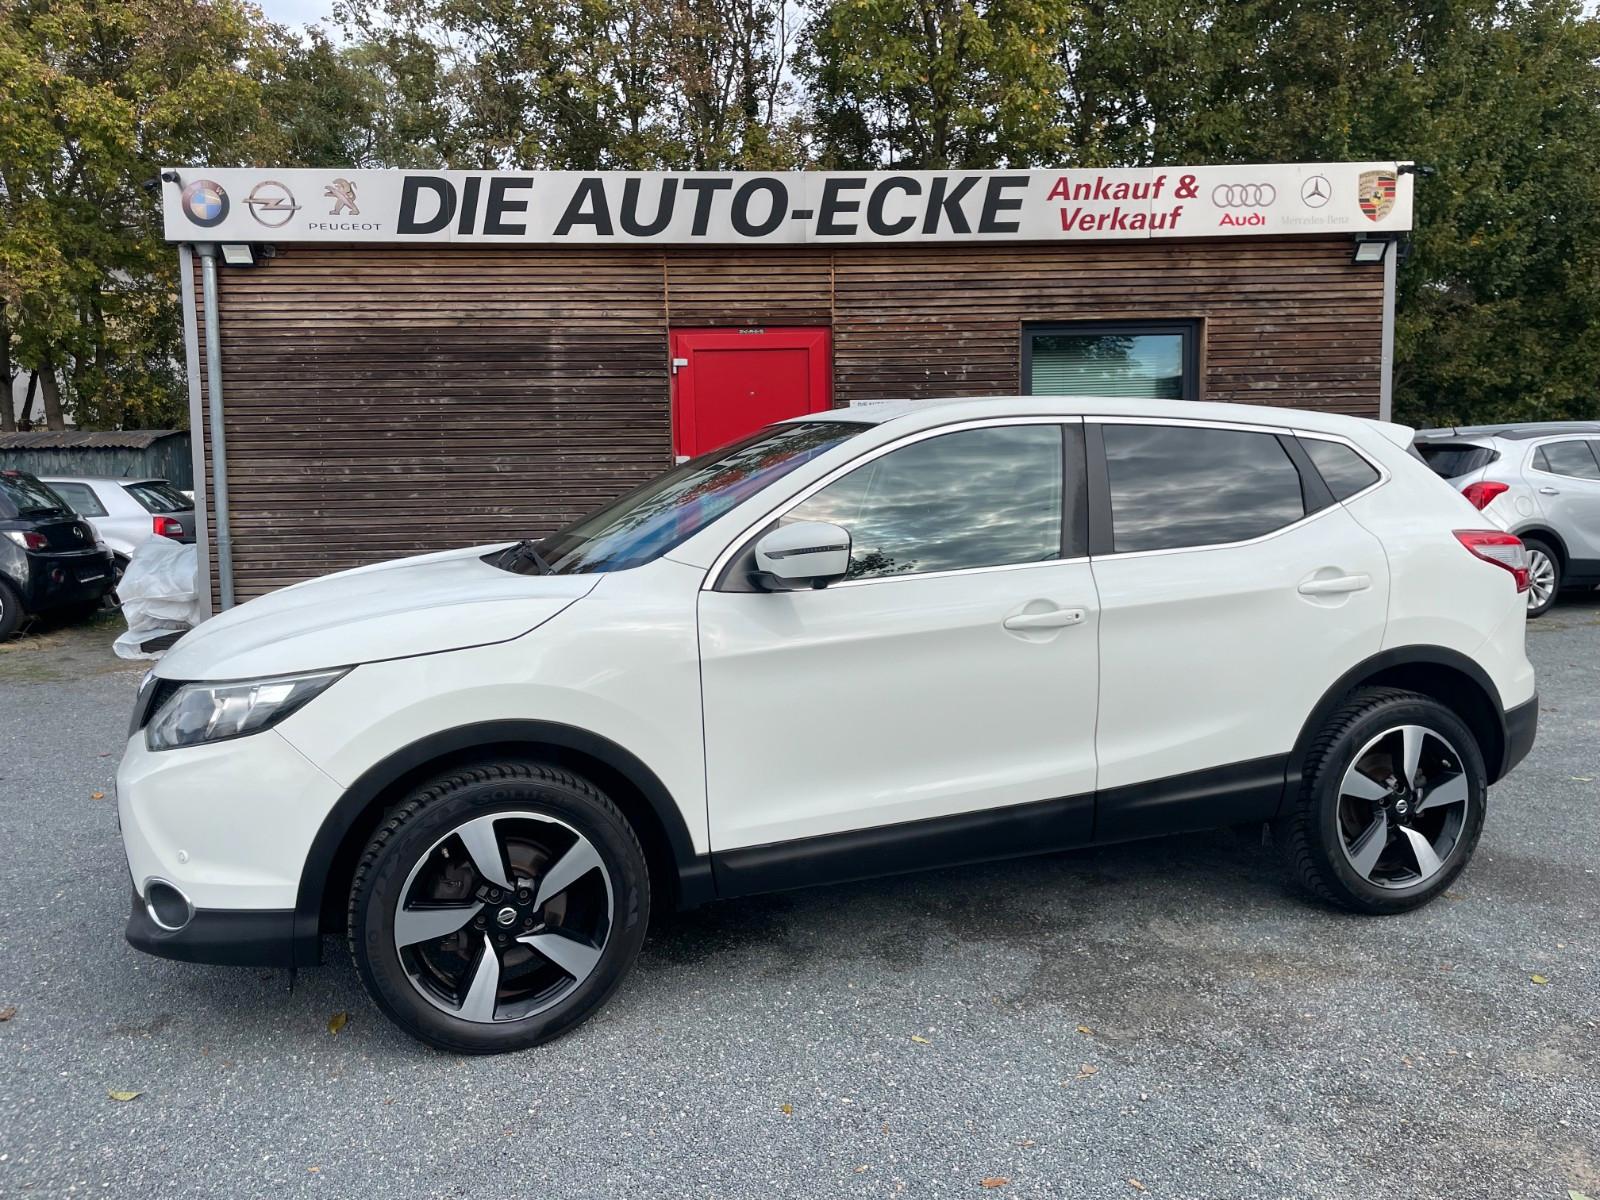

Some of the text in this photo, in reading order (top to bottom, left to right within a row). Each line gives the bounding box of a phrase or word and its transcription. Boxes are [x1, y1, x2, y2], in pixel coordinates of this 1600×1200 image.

[1047, 175, 1199, 200] Ankauf &
[397, 176, 1030, 237] DIE AUTO-ECKE
[1060, 206, 1182, 231] Verkauf
[308, 222, 382, 231] PEUGEOT
[1219, 213, 1266, 226] Audi
